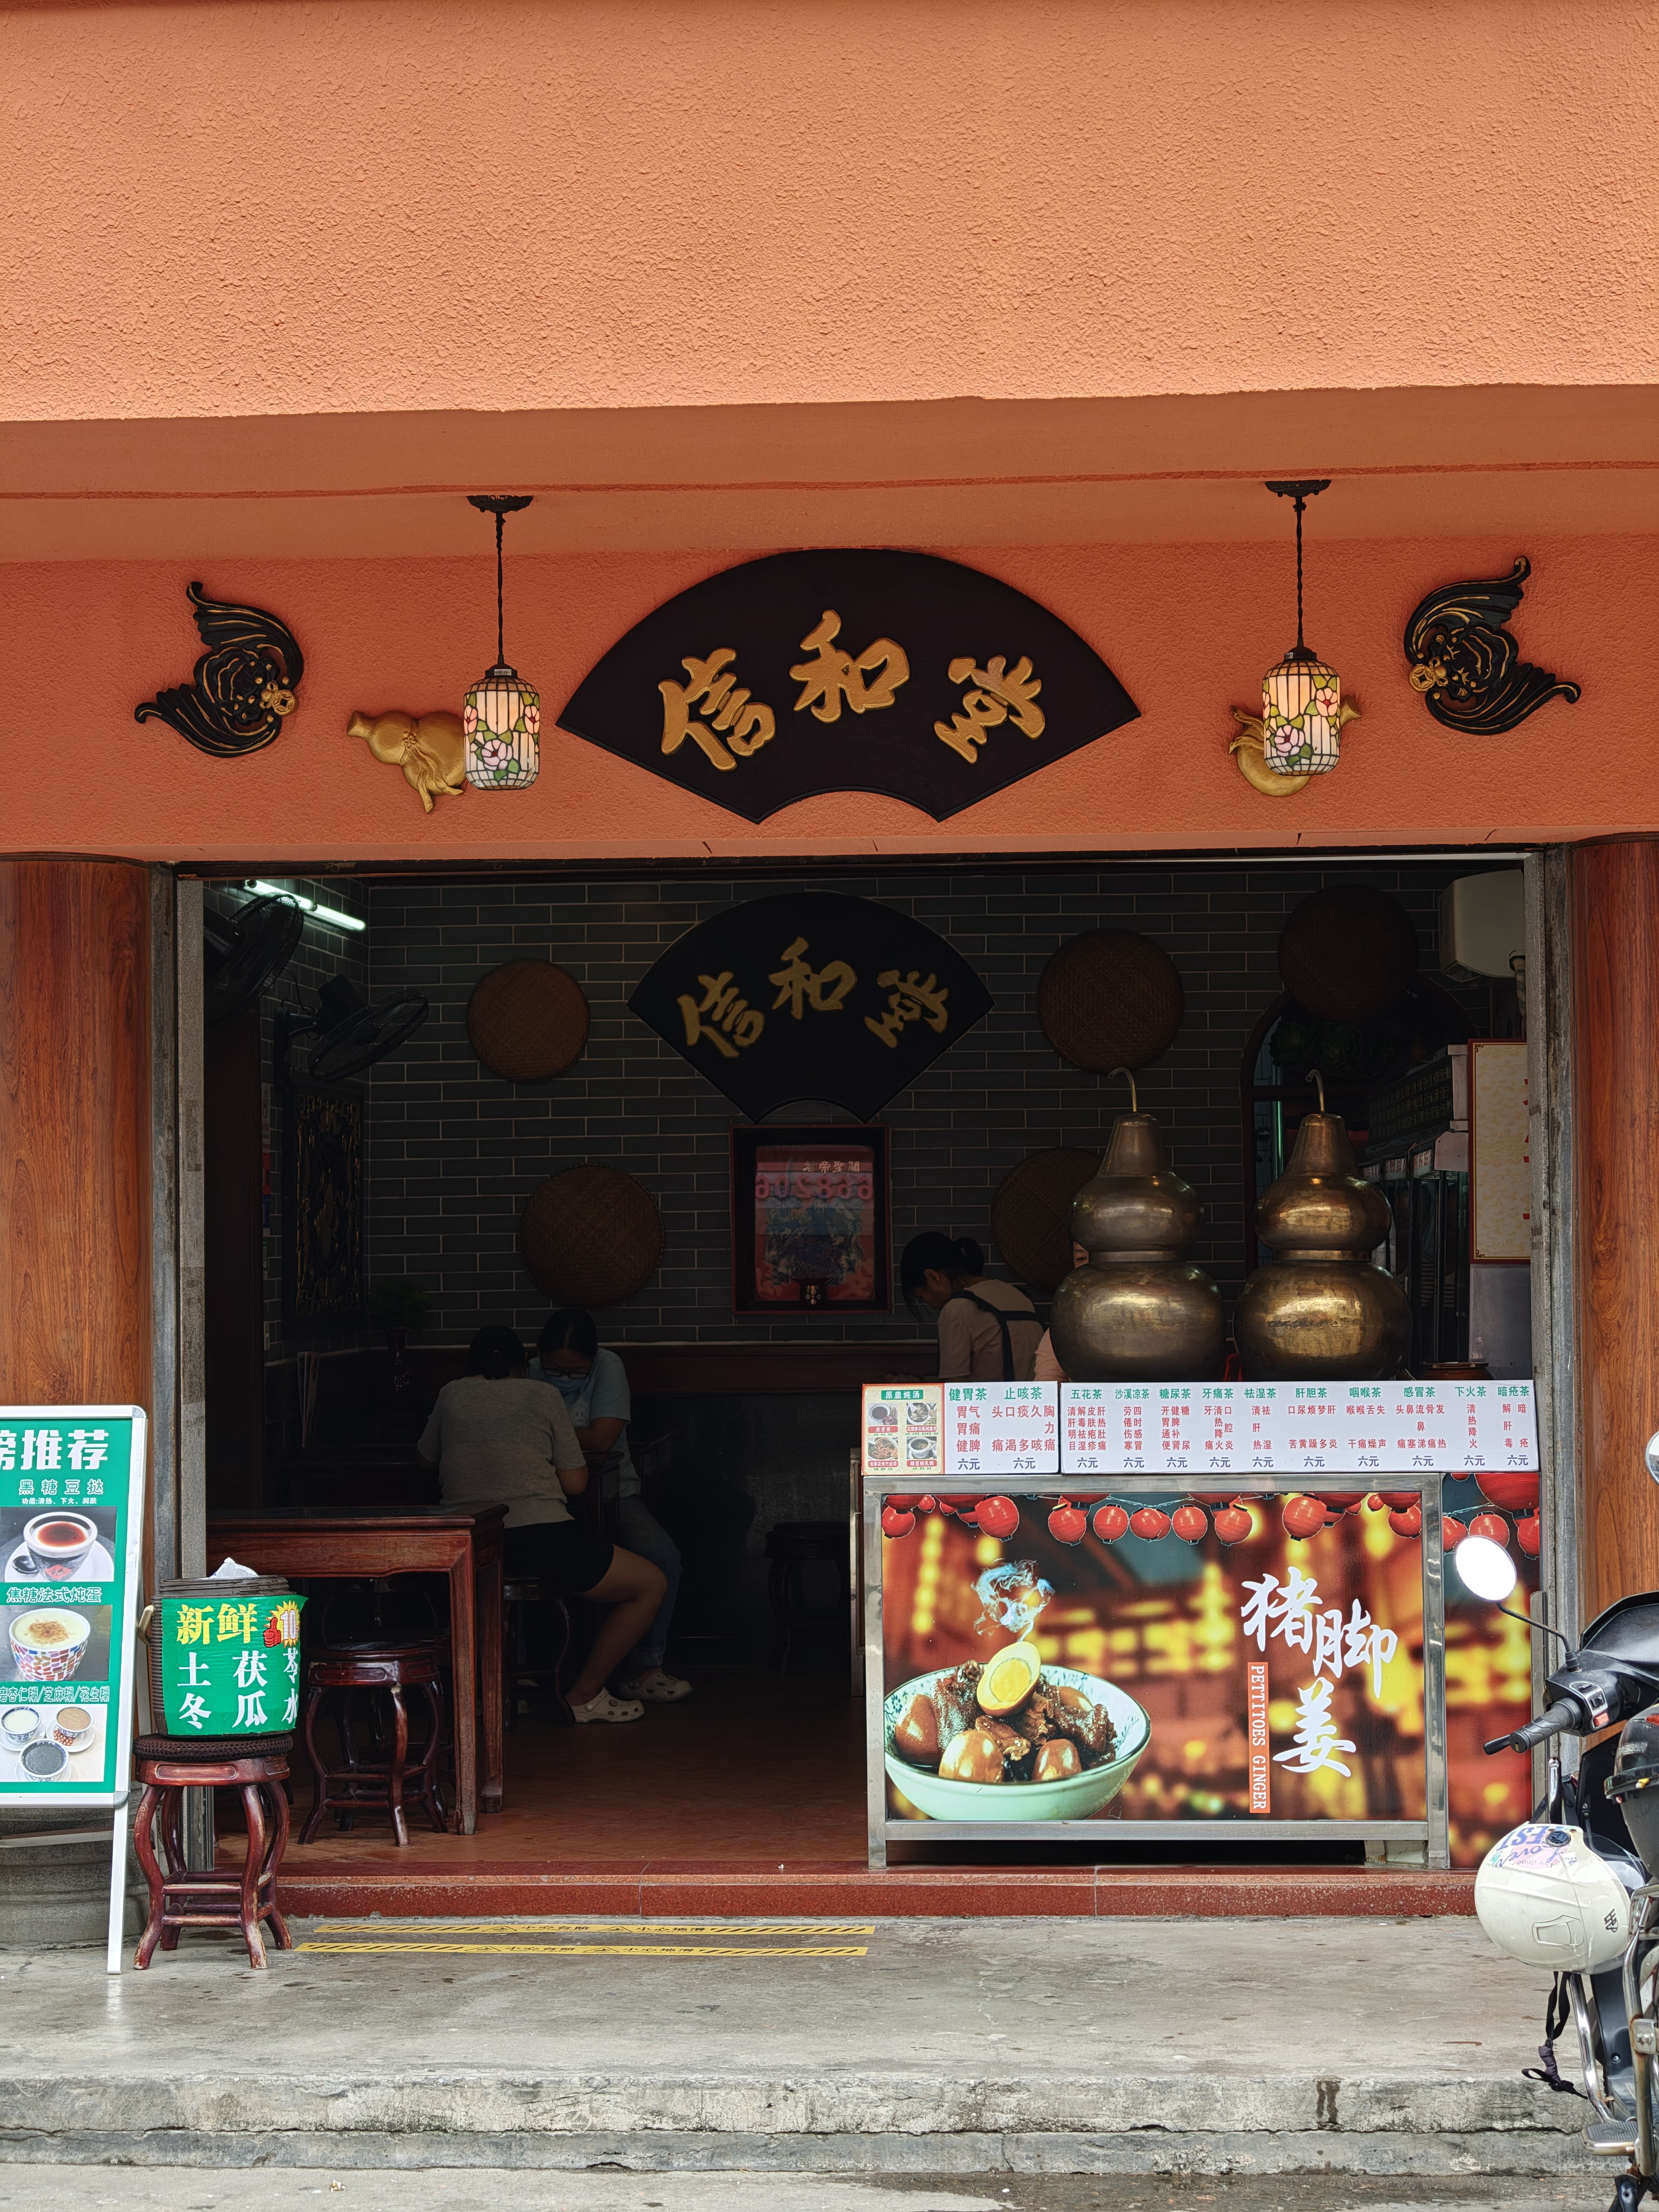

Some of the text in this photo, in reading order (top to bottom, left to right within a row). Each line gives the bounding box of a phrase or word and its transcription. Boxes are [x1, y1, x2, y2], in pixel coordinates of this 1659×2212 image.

[949, 1387, 987, 1401] 健胃茶
[1004, 1386, 1042, 1400] 止咳茶
[1071, 1389, 1102, 1400] 五花茶
[1115, 1388, 1149, 1399] 沙溪凉茶
[1159, 1388, 1191, 1399] 糖尿茶
[1202, 1388, 1233, 1399] 牙痛茶
[1244, 1388, 1276, 1398] 祛湿茶
[1296, 1387, 1327, 1398] 肝胆茶
[1350, 1387, 1381, 1398] 咽喉茶
[1404, 1386, 1435, 1397] 感冒茶
[1454, 1386, 1486, 1397] 下火茶
[1498, 1385, 1529, 1397] 暗疮茶
[957, 1458, 980, 1470] 六元
[1013, 1457, 1036, 1469] 六元
[1077, 1457, 1098, 1468] 六元
[1123, 1457, 1144, 1468] 六元
[1166, 1457, 1188, 1468] 六元
[1209, 1456, 1231, 1468] 六元
[1252, 1456, 1273, 1467] 六元
[1304, 1456, 1325, 1467] 六元
[1358, 1456, 1379, 1467] 六元
[1412, 1455, 1434, 1466] 六元
[1464, 1455, 1485, 1466] 六元
[1507, 1454, 1528, 1466] 六元
[6, 1587, 102, 1603] 焦糖法式炖蛋
[176, 1603, 258, 1645] 新鲜
[1251, 1665, 1266, 1810] PETTITOES GINGER
